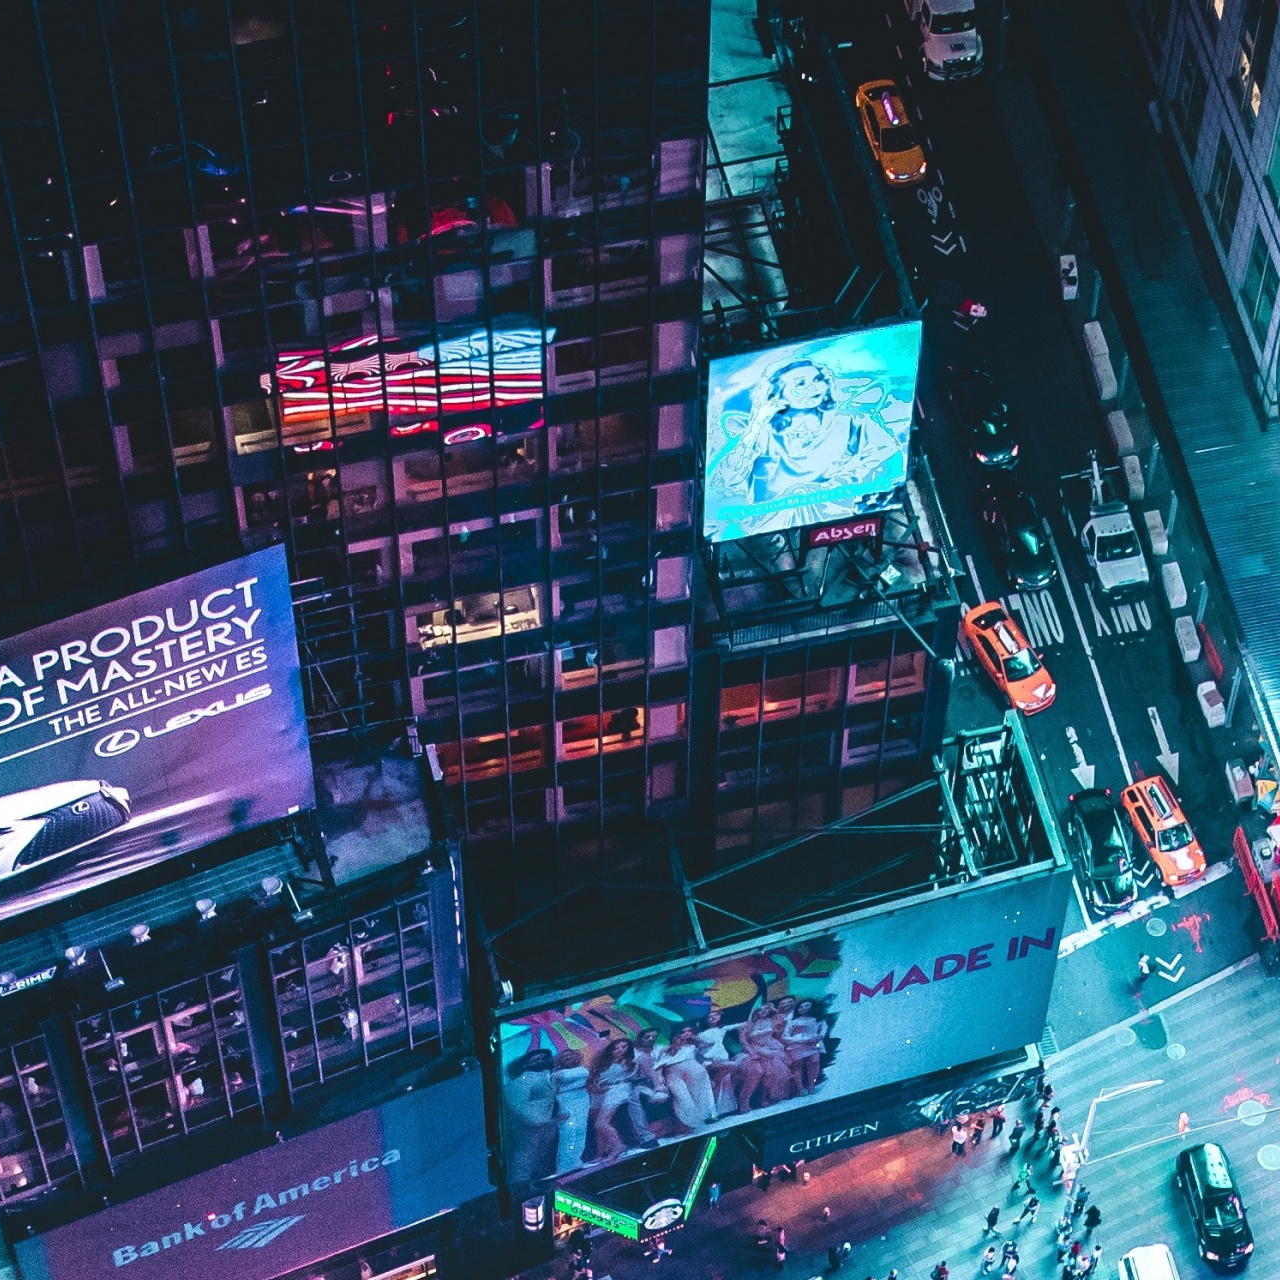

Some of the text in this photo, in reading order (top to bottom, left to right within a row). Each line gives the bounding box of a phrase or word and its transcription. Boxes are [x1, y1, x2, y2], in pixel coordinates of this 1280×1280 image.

[814, 522, 877, 543] Absen
[32, 577, 259, 680] PRODUCT
[57, 608, 262, 706] MASTERY
[49, 647, 268, 735] THE ALL-NEW ES
[144, 683, 272, 738] LEXUS
[850, 927, 1057, 1003] MADE IN
[789, 1120, 881, 1154] CITIZEN
[111, 1148, 401, 1268] Bank of America
